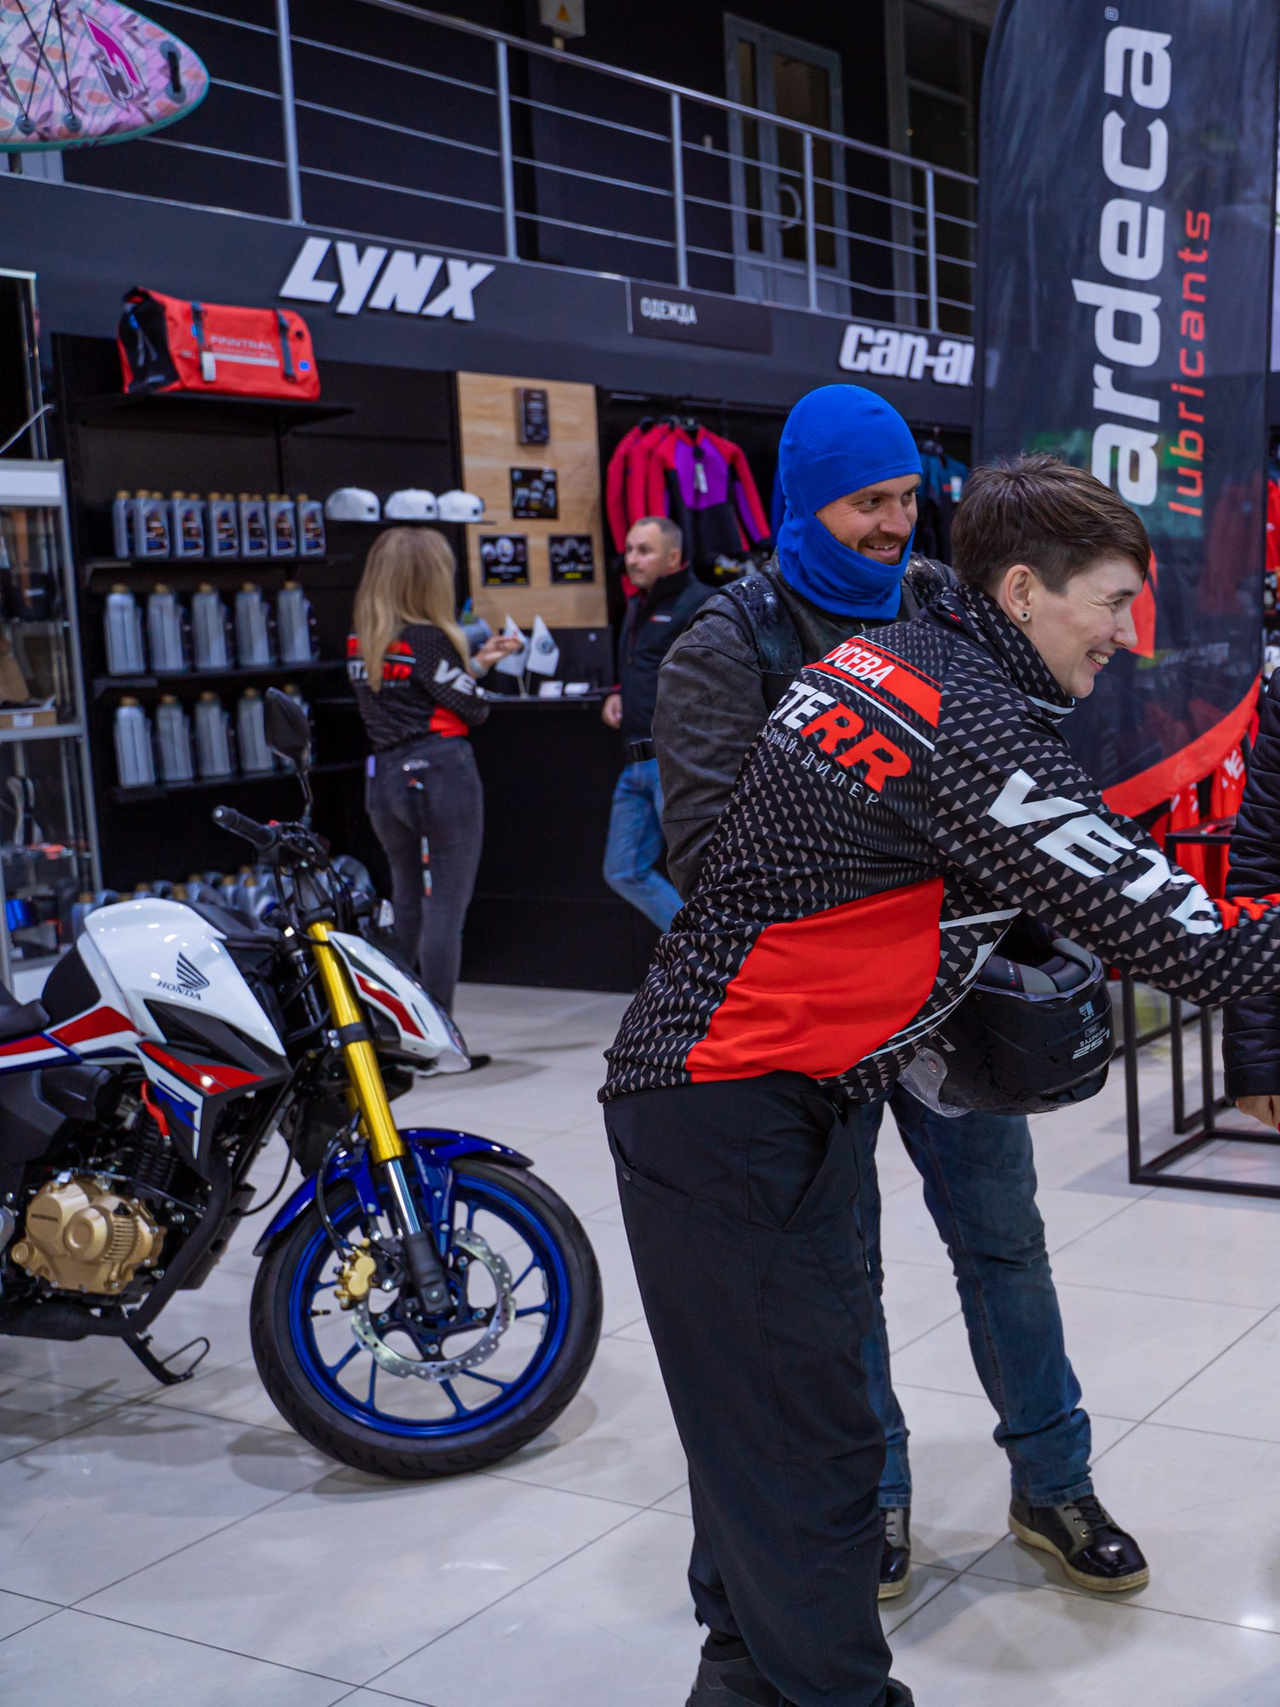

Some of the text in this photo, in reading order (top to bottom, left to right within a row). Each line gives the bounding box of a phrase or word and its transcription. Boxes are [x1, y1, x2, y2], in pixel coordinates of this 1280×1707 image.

[279, 236, 495, 321] LYNX
[1071, 25, 1173, 506] ardeca
[640, 297, 698, 326] ОДЕЖДА
[1168, 209, 1212, 517] lubricants
[823, 643, 896, 688] УСЕВА
[769, 681, 912, 793] TERR
[801, 751, 879, 805] ДИЛЕР
[157, 980, 202, 1001] HONDA
[1072, 1028, 1111, 1060] LS2
